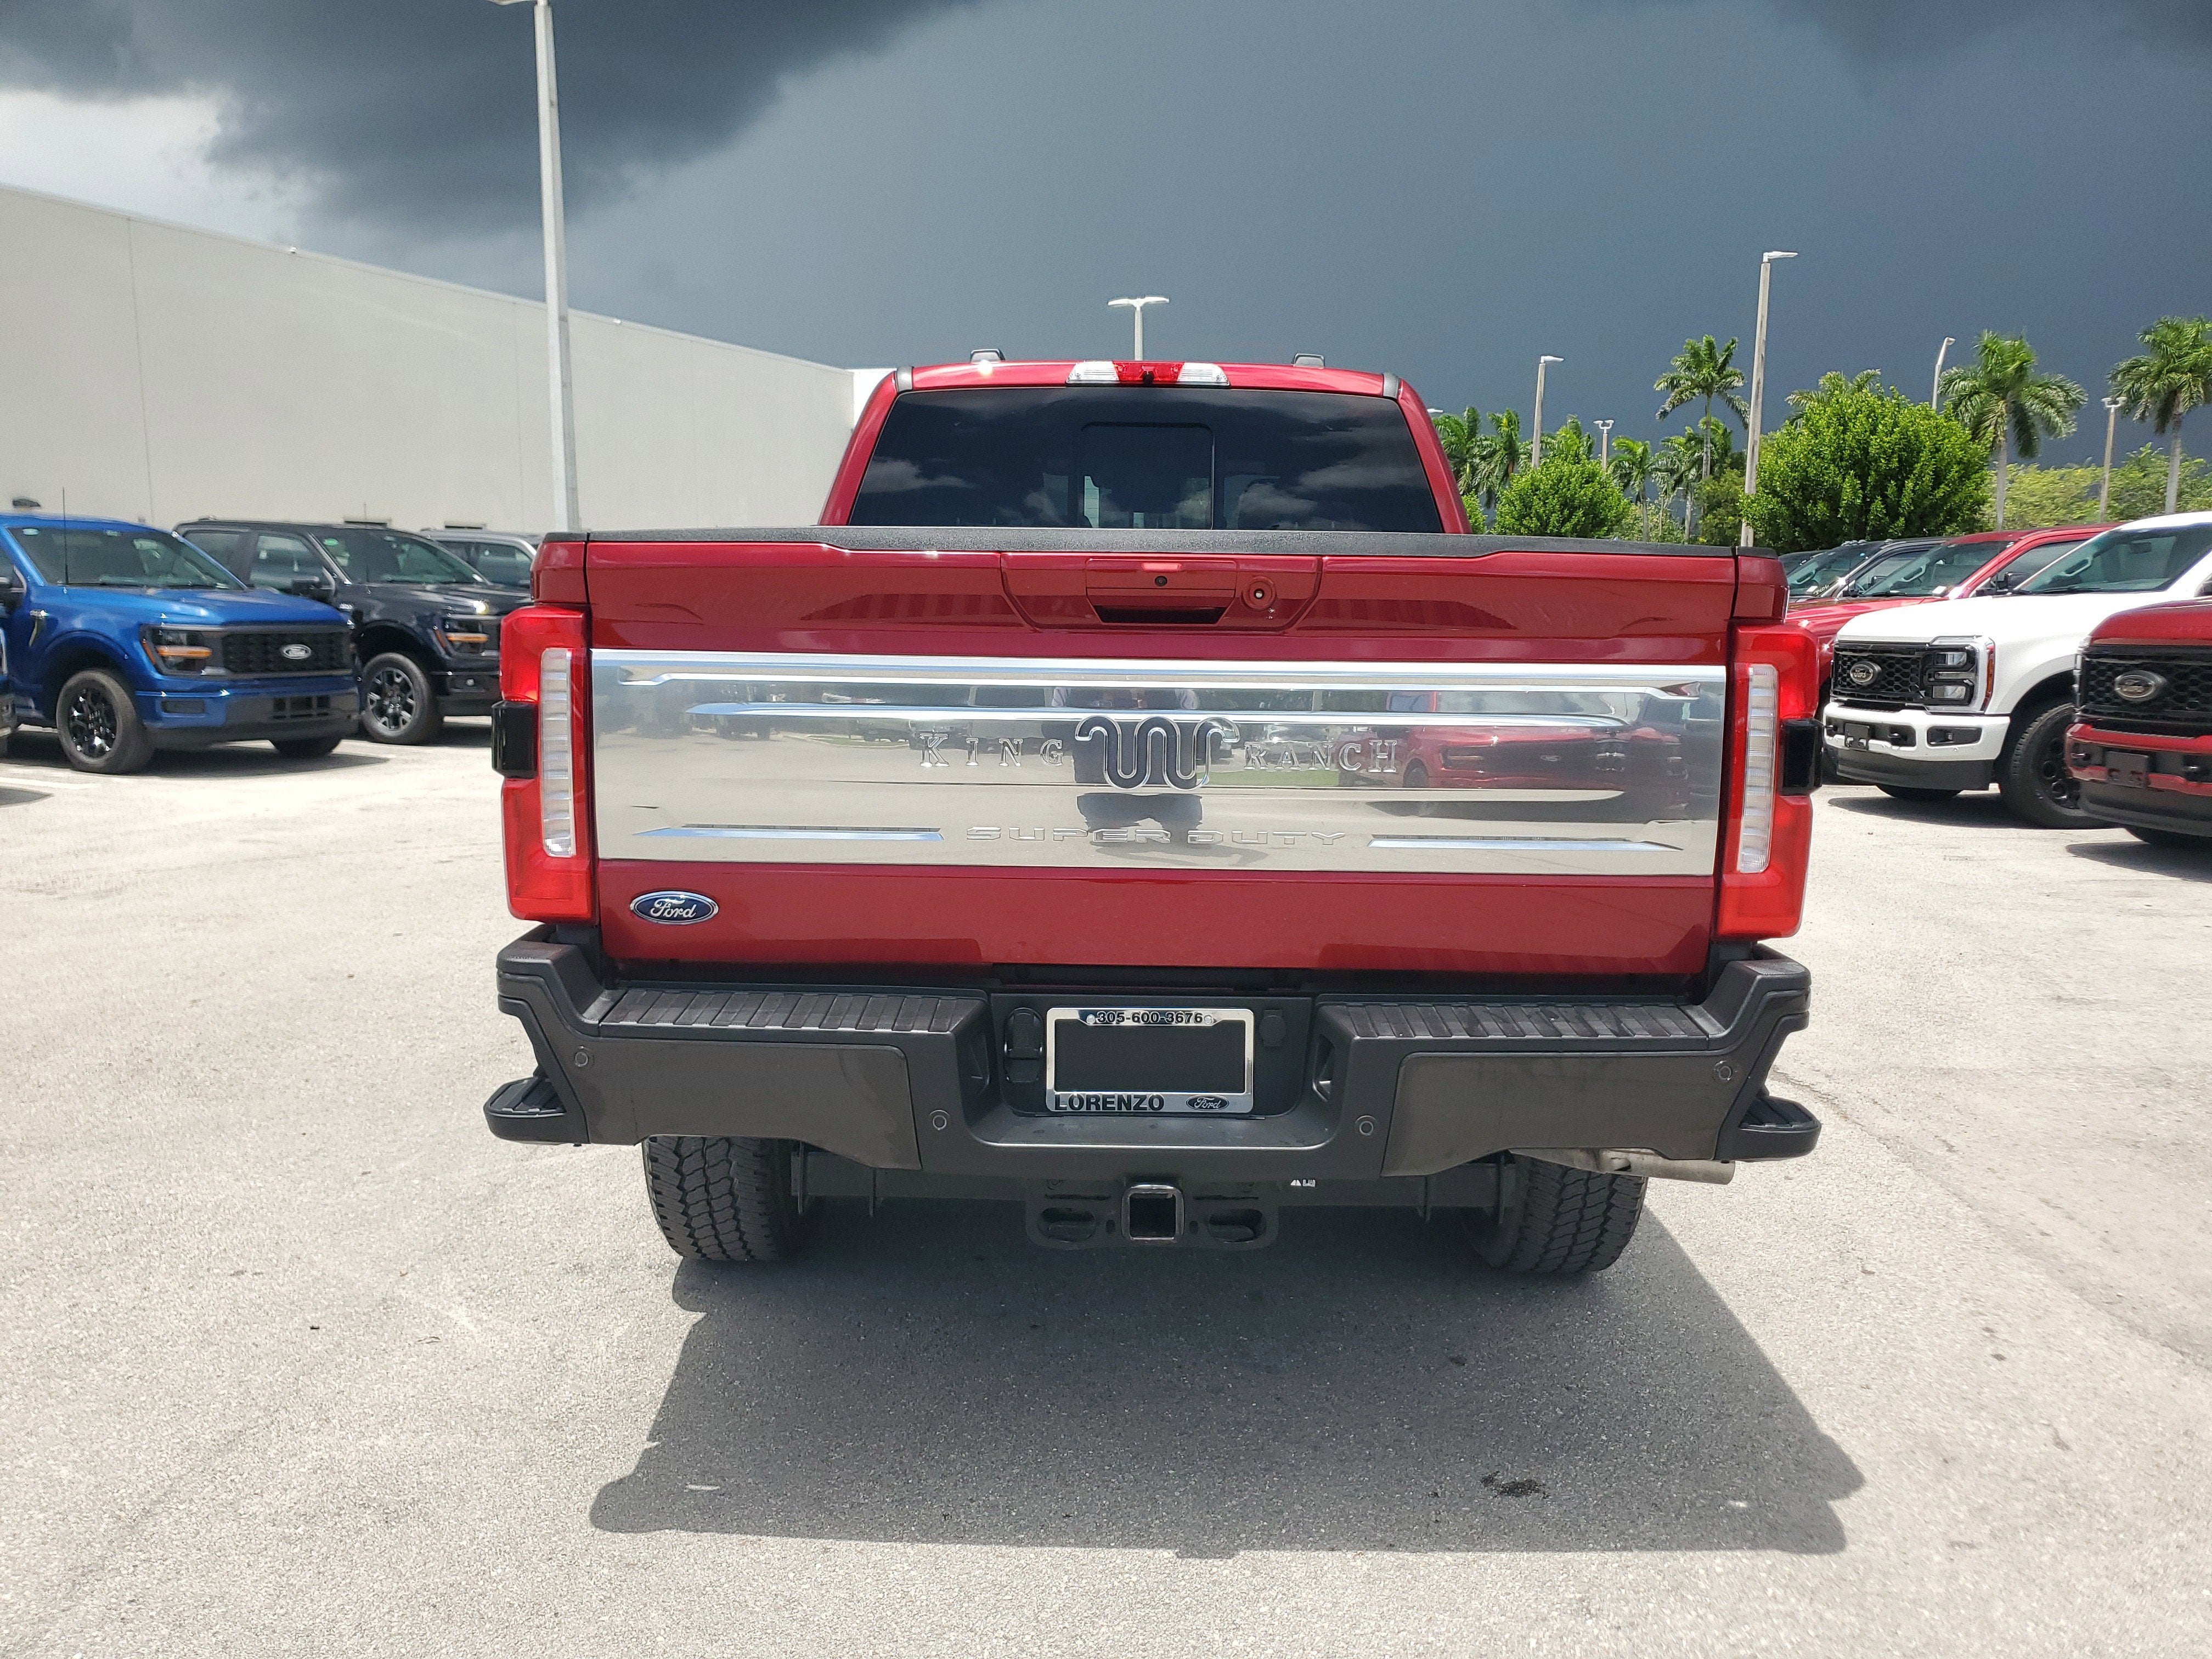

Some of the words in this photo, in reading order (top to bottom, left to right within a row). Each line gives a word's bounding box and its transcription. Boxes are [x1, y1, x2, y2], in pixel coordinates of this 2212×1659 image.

[919, 733, 1063, 767] KING
[1244, 740, 1397, 772] RANCH
[966, 827, 1171, 843] SUPER
[1187, 830, 1345, 845] DUTY
[650, 898, 697, 918] Ford
[1097, 1011, 1204, 1024] 305-600-3676
[1054, 1093, 1165, 1111] LORENZO
[1193, 1097, 1222, 1110] Ford
